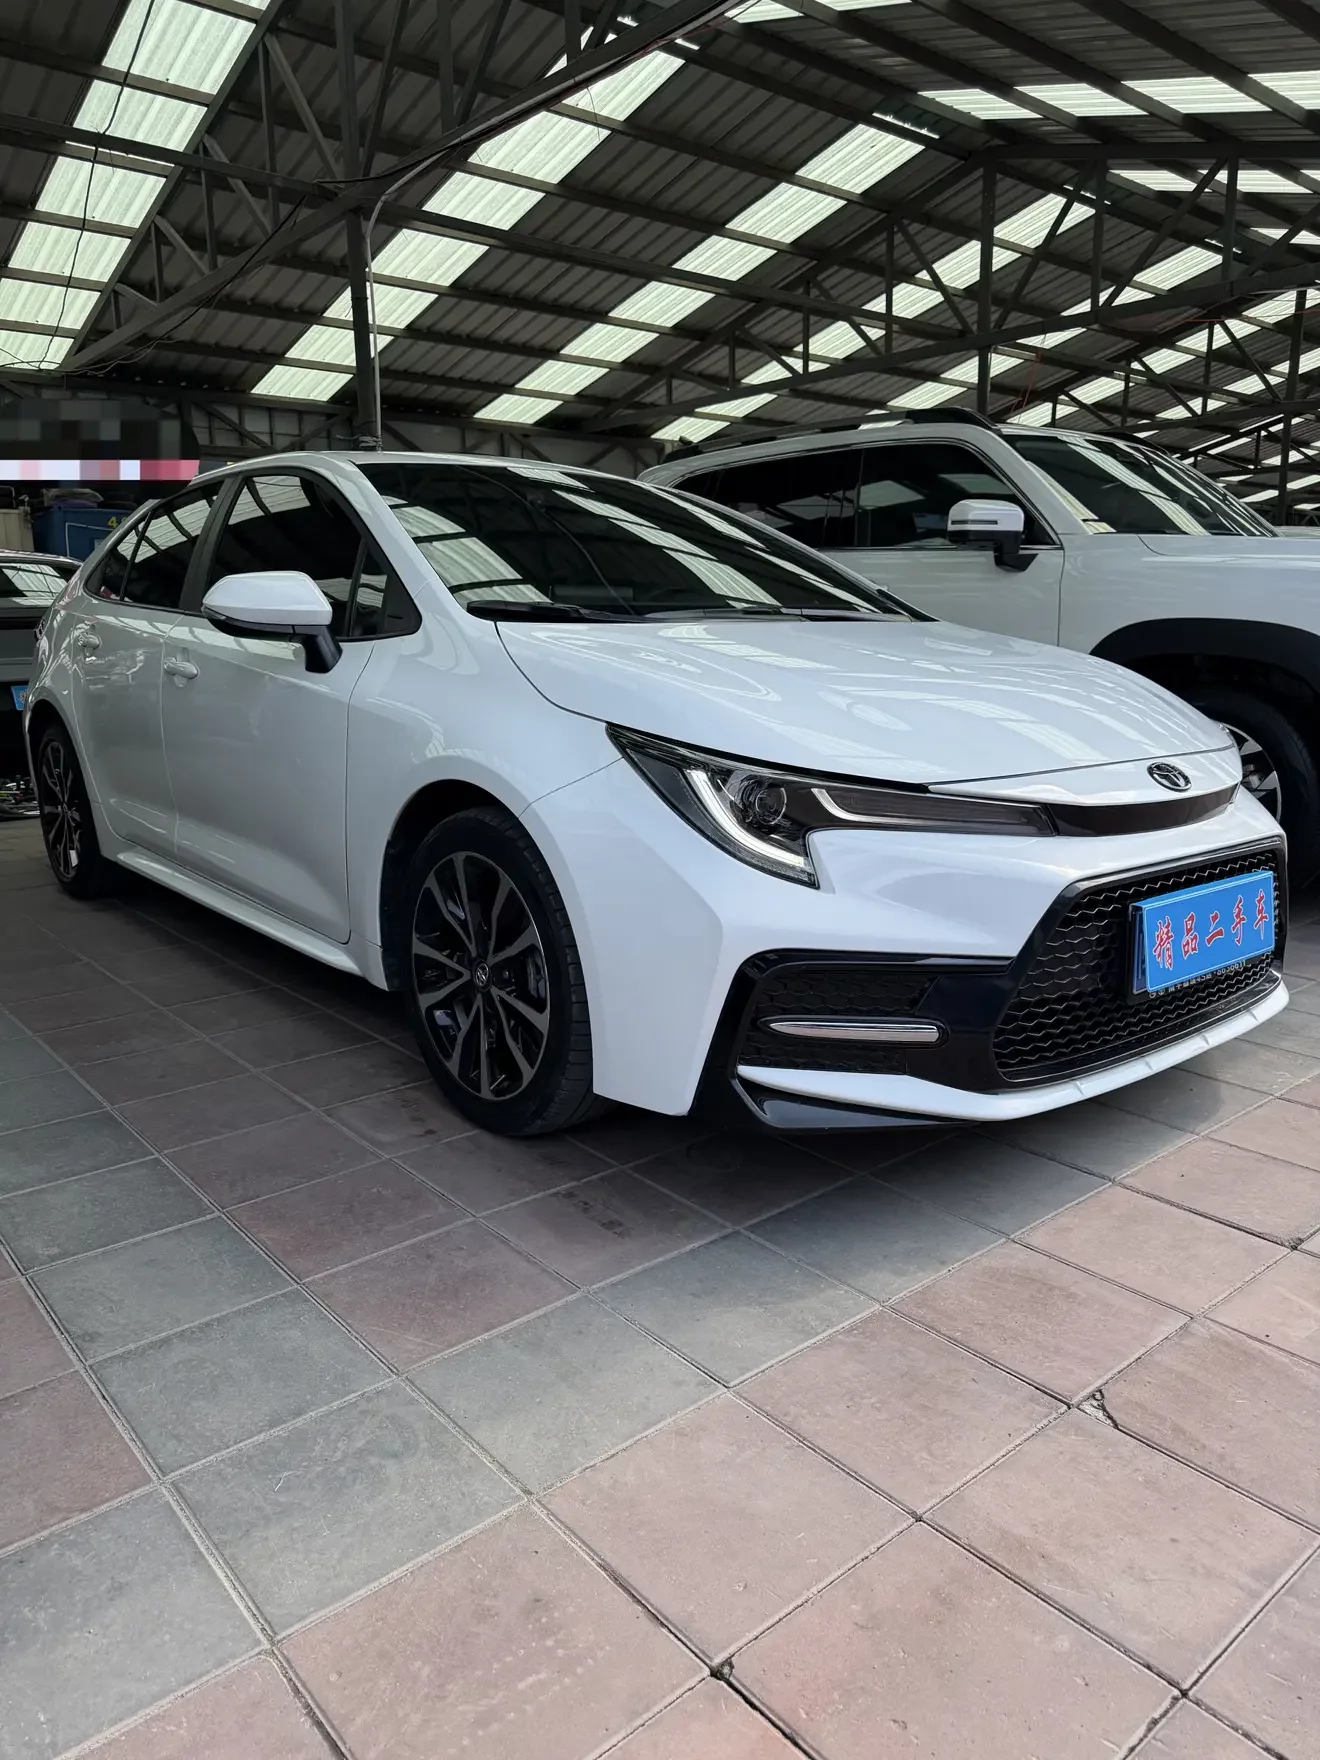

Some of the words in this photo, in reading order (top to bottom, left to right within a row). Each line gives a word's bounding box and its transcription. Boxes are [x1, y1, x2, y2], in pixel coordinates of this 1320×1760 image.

[1153, 888, 1269, 971] 精品二手车
